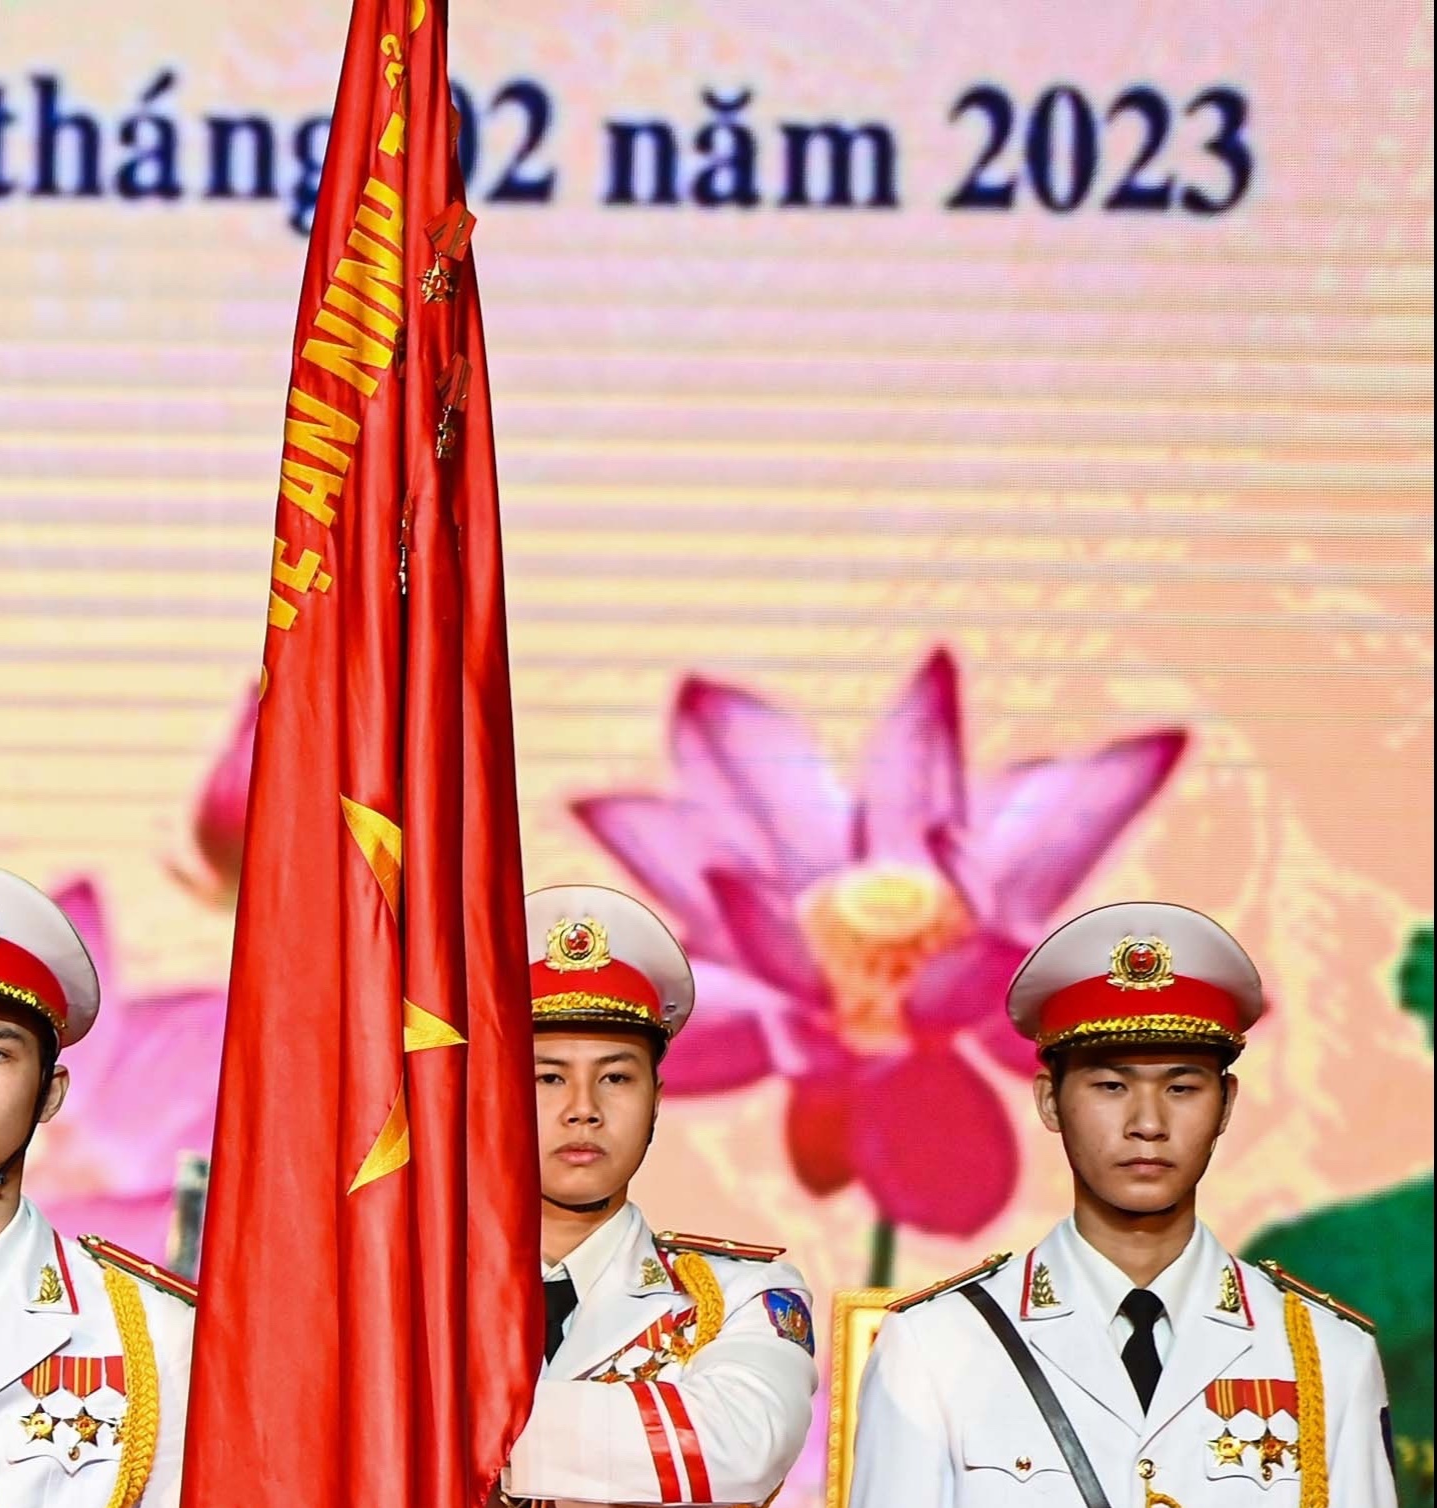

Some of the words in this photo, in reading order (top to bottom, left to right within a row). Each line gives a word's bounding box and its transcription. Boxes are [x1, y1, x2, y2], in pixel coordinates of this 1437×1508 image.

[603, 86, 901, 211] năm
[943, 83, 1255, 215] 2023
[301, 176, 404, 398] NINH
[280, 386, 361, 528] AN
